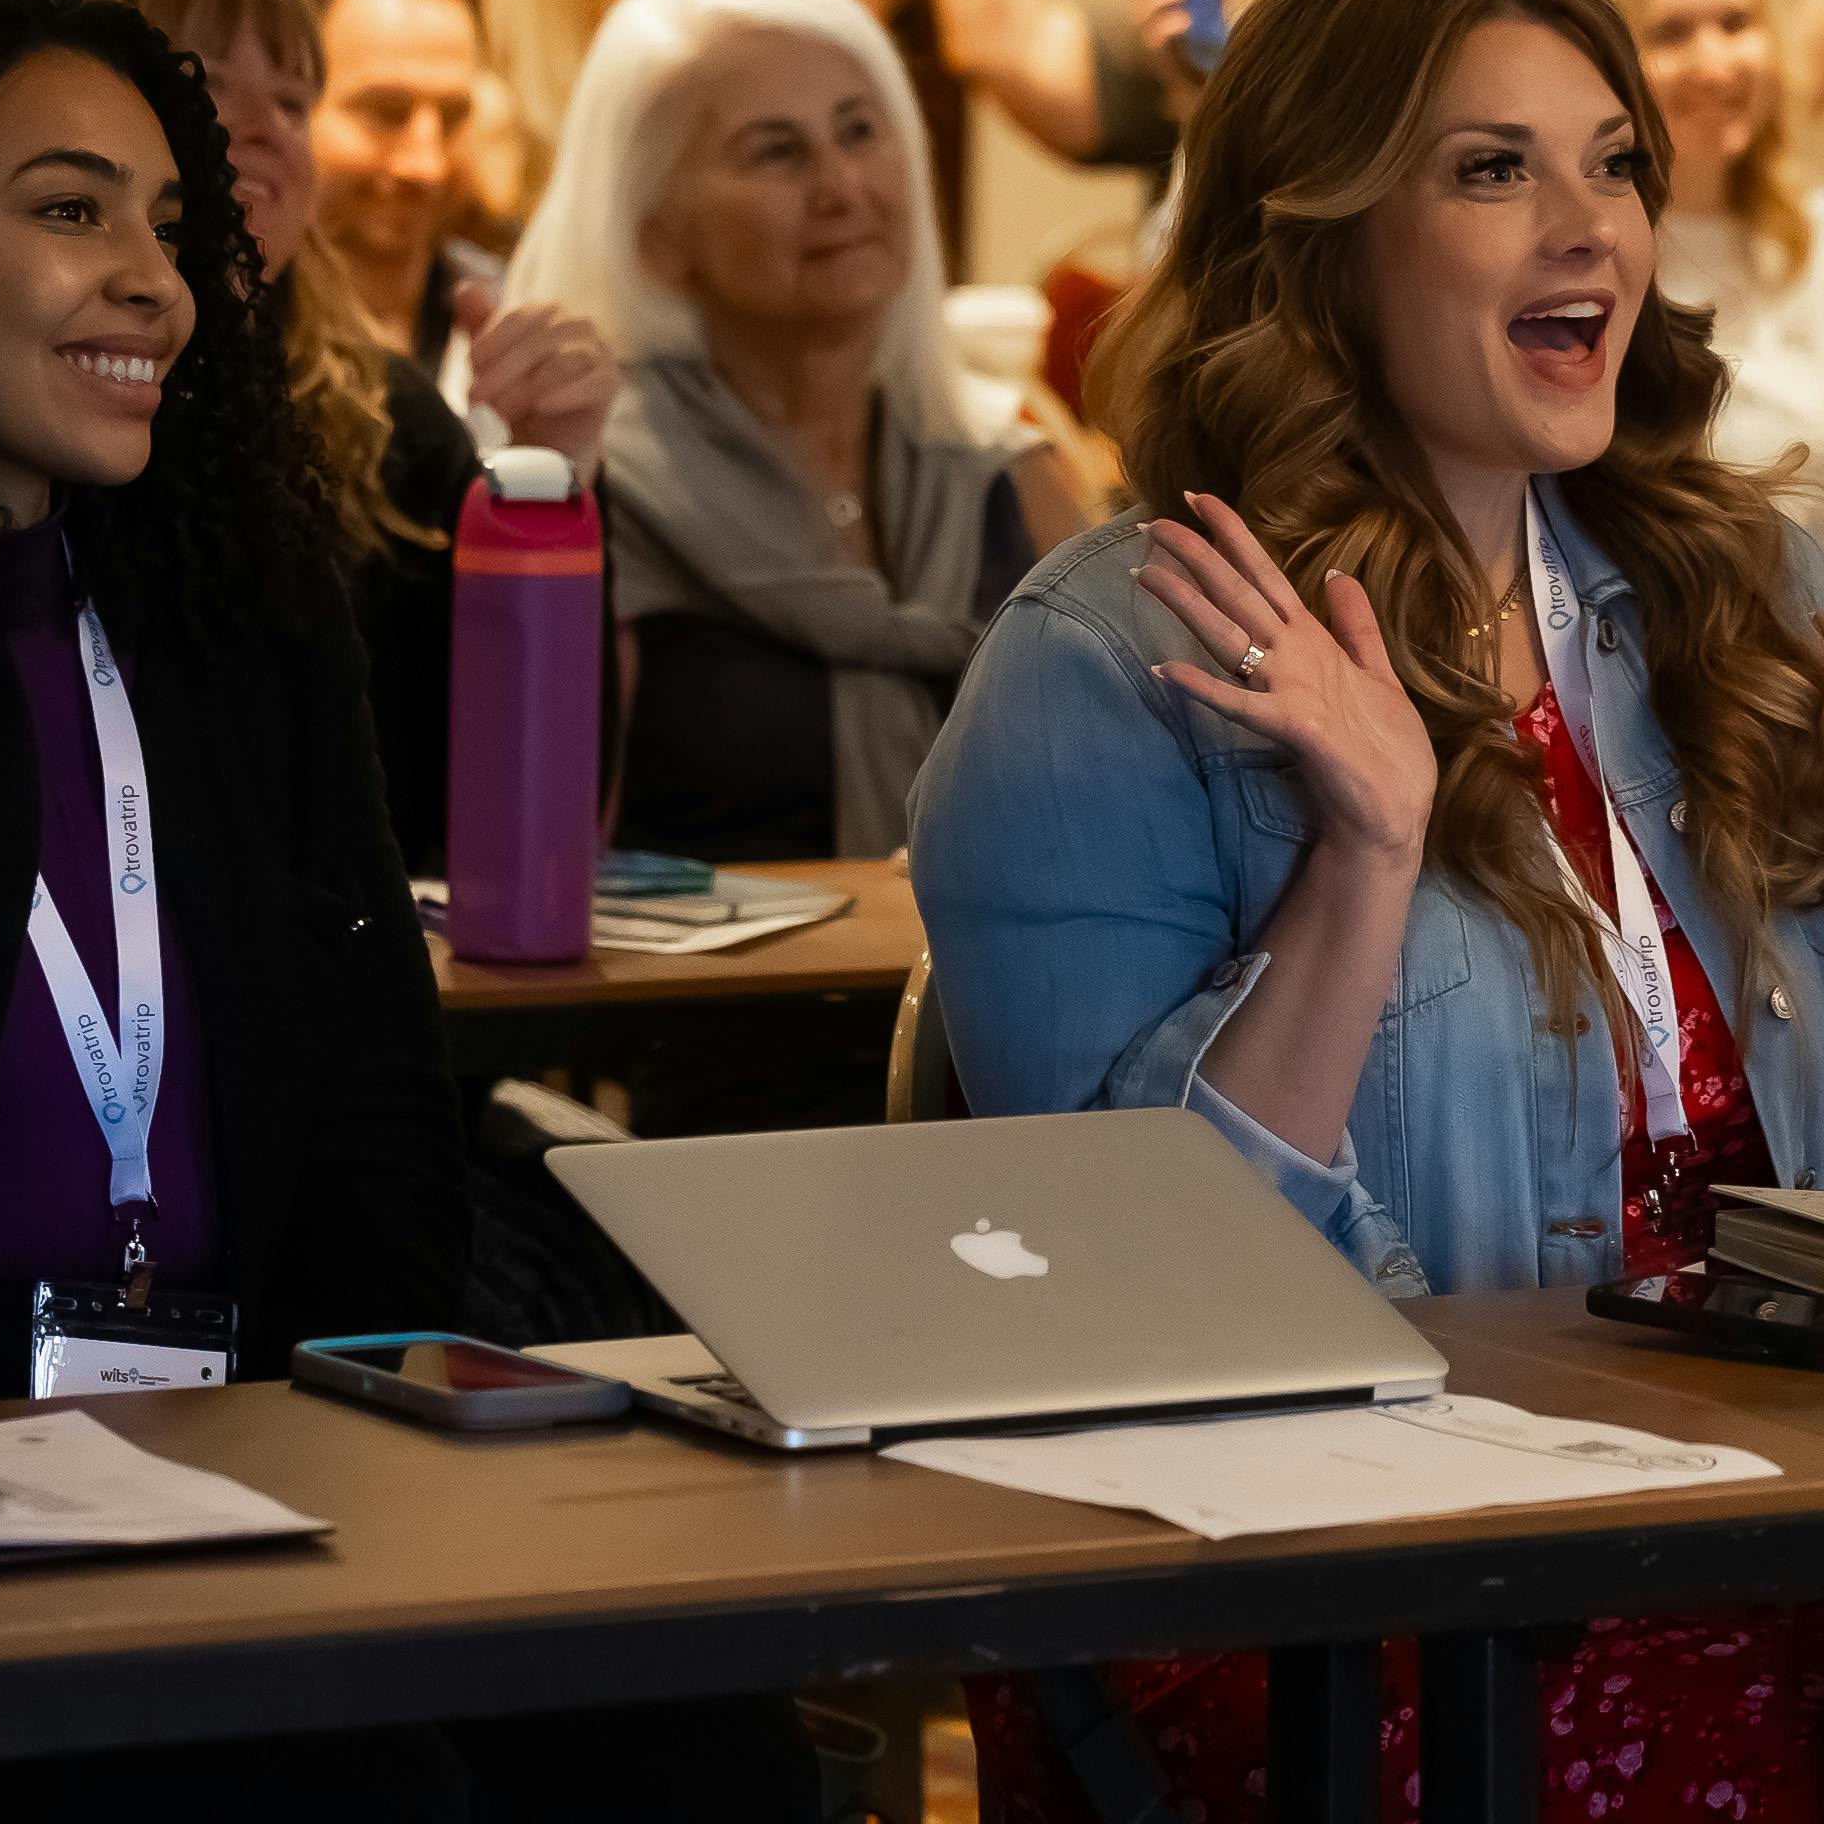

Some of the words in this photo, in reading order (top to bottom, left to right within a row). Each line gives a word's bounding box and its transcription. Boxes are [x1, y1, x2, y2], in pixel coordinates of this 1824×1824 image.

[117, 784, 141, 873] trovatrip
[1639, 935, 1664, 1025] trovatrip
[77, 1014, 118, 1102] trovatrip
[132, 1003, 156, 1095] trovatrip
[100, 1367, 129, 1384] wits
